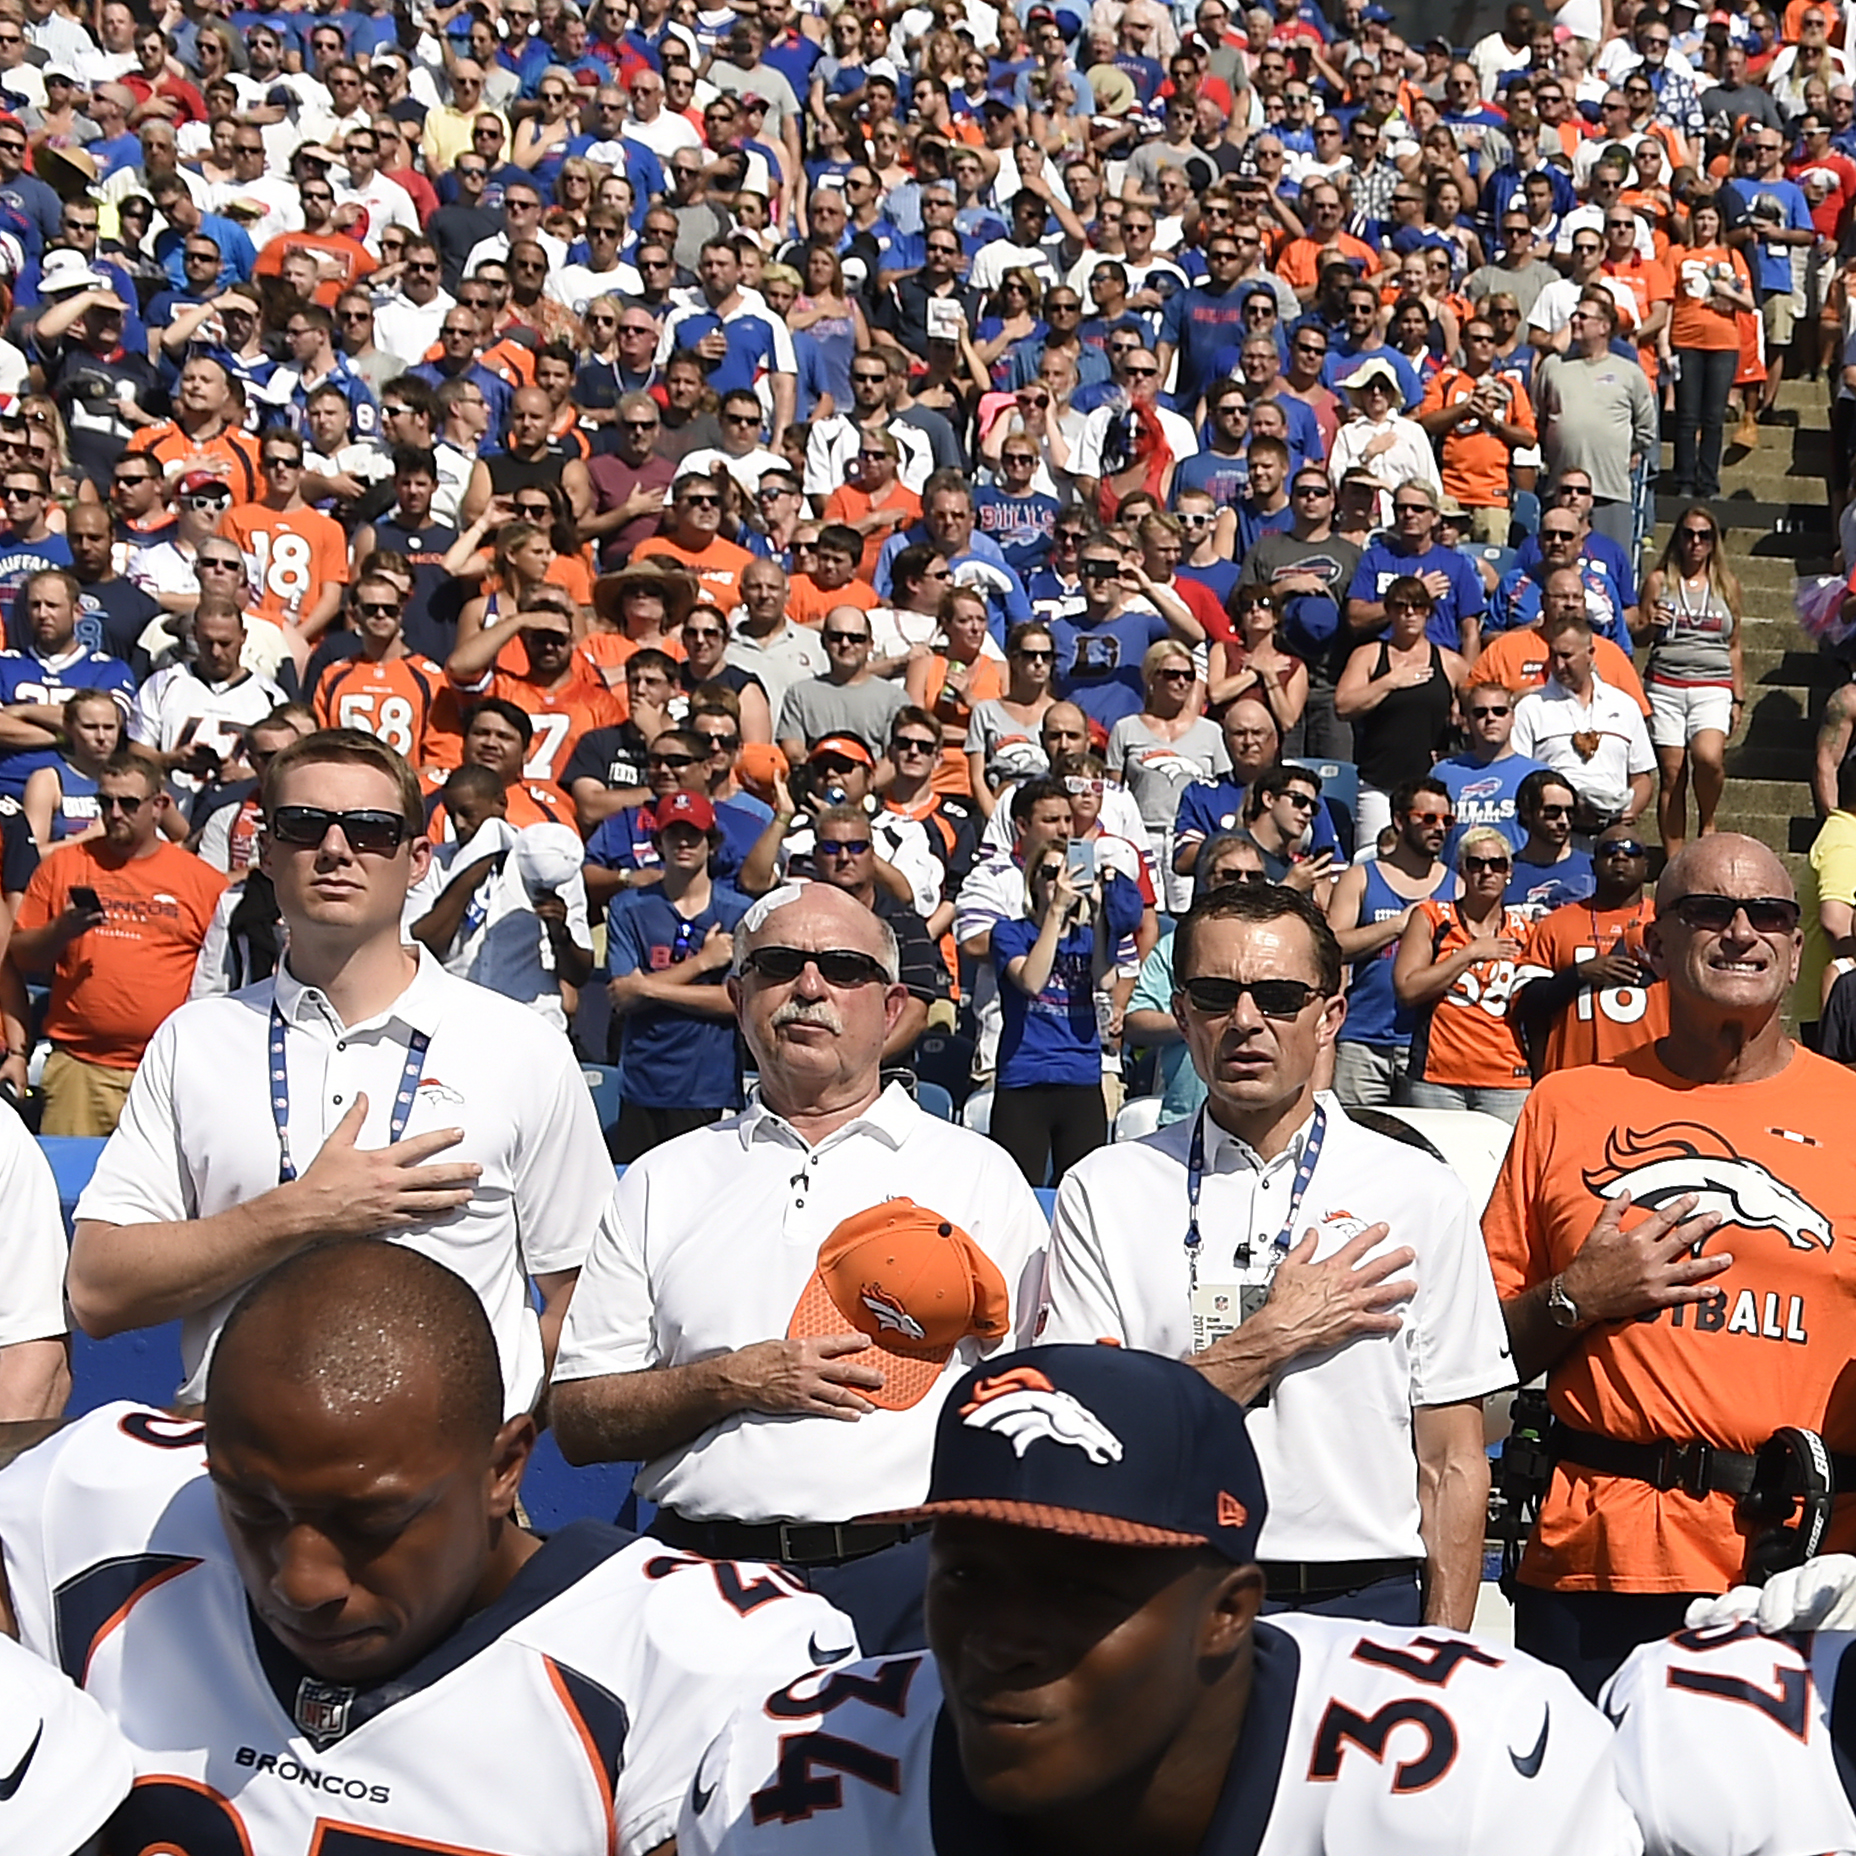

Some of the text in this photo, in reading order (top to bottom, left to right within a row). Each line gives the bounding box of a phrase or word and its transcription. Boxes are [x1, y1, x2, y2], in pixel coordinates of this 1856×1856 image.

[252, 532, 312, 604] 18
[340, 692, 412, 758] 58
[749, 1656, 921, 1828] 34
[1305, 1634, 1508, 1795] 34
[234, 1746, 391, 1806] BRONCOS
